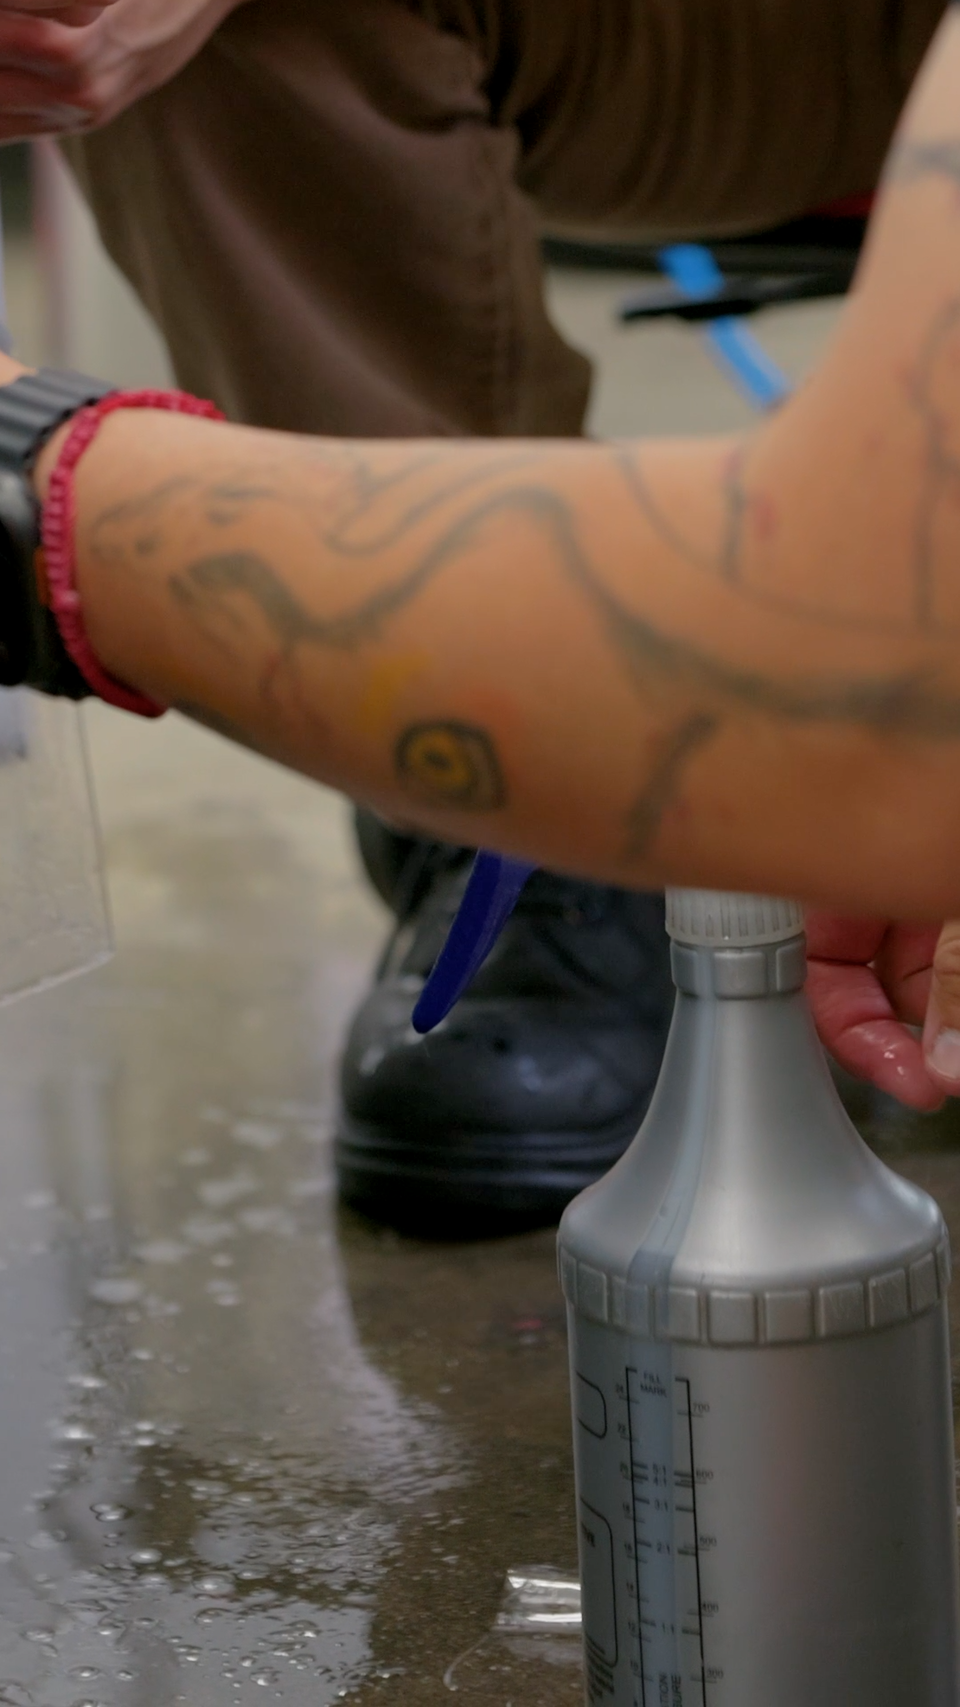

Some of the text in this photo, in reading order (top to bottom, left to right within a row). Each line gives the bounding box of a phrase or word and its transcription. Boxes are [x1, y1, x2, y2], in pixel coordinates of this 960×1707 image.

[640, 1382, 667, 1397] MARK
[693, 1402, 710, 1413] 700
[696, 1468, 714, 1480] 600
[699, 1535, 717, 1547] 500
[702, 1601, 719, 1613] 400
